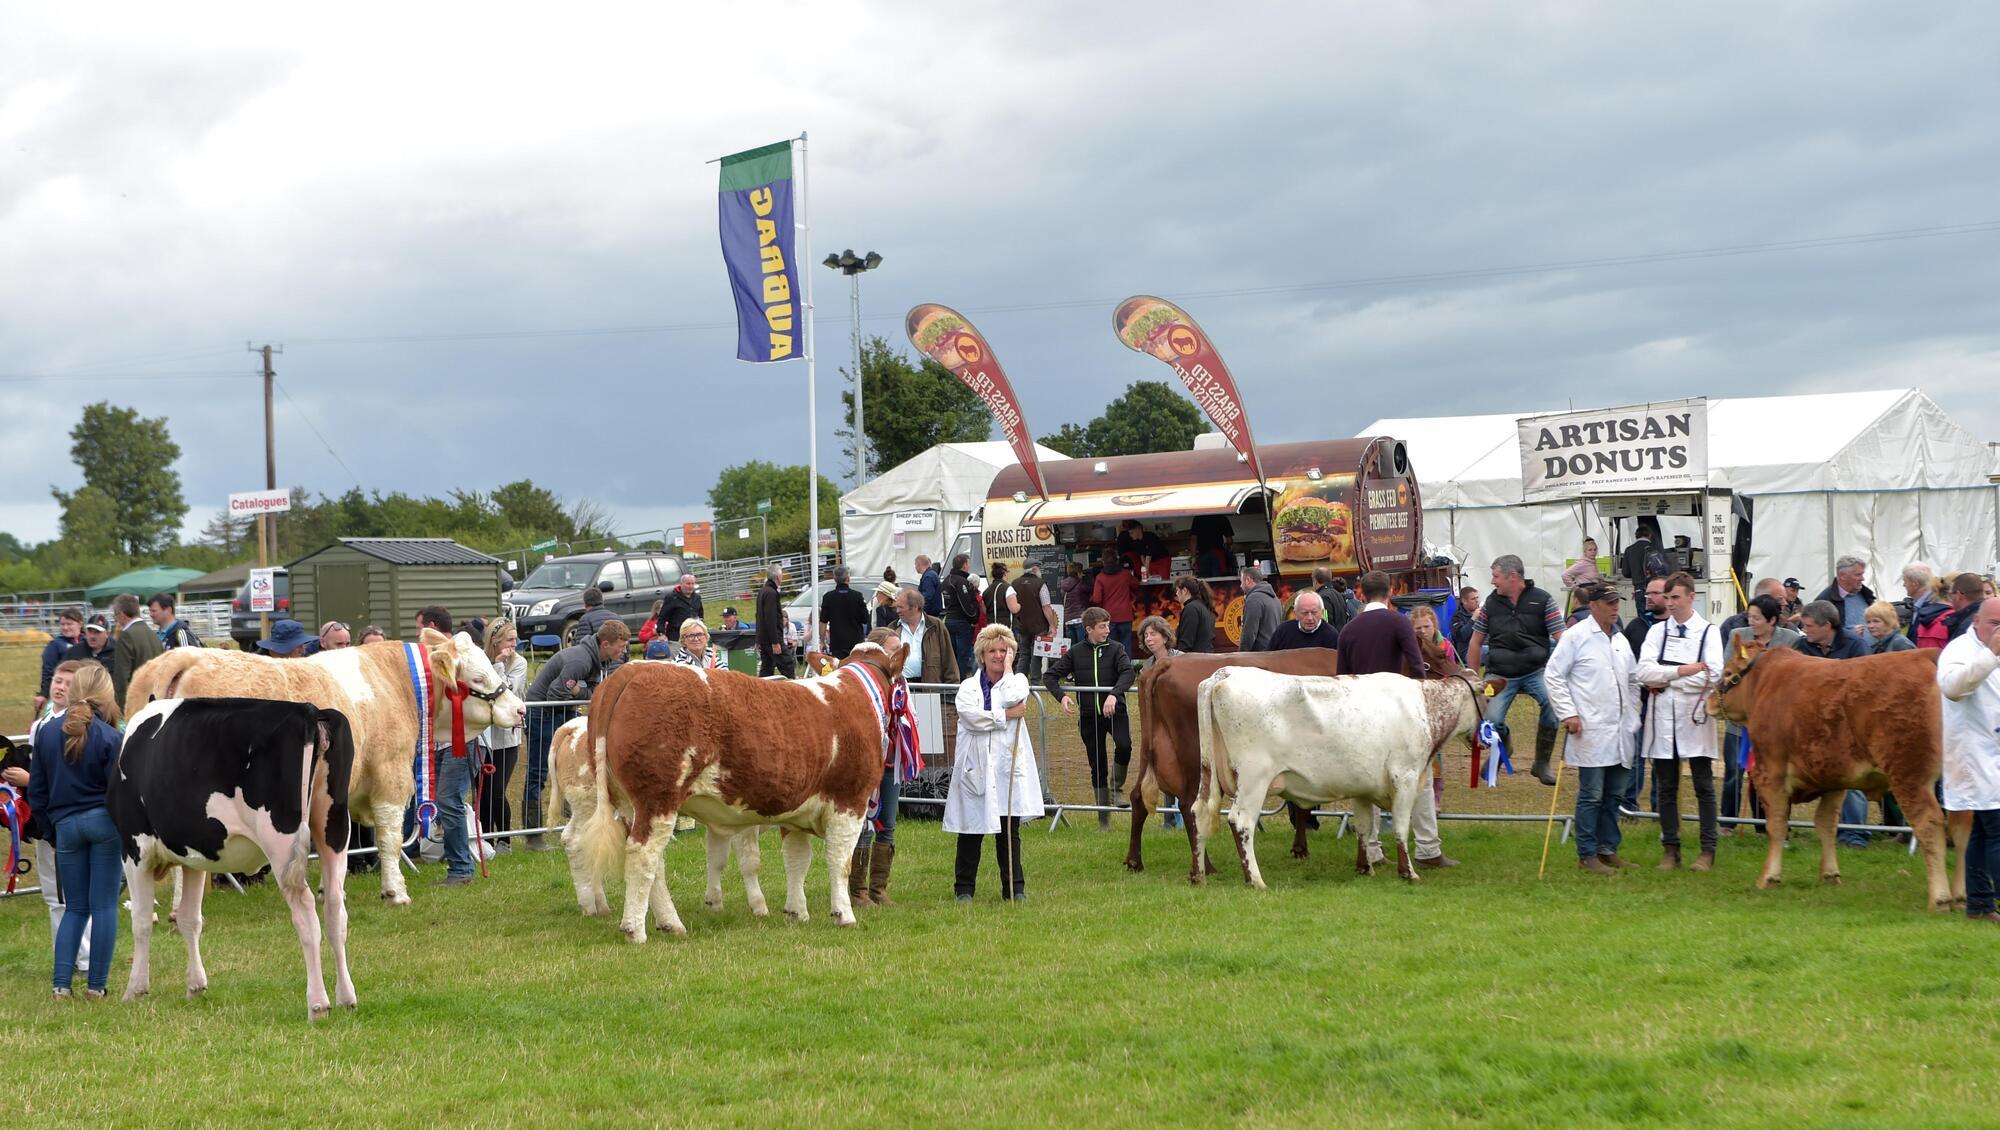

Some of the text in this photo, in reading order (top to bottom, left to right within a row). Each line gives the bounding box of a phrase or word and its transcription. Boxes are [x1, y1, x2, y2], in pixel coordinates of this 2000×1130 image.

[1535, 413, 1691, 451] ARTISAN
[1543, 445, 1688, 480] DONUTS
[231, 497, 289, 510] Catalogues
[1368, 489, 1397, 509] GRASS FED
[1398, 512, 1409, 528] BEEF
[985, 528, 1032, 545] GRASS FED
[987, 545, 1032, 559] PIEMONTES
